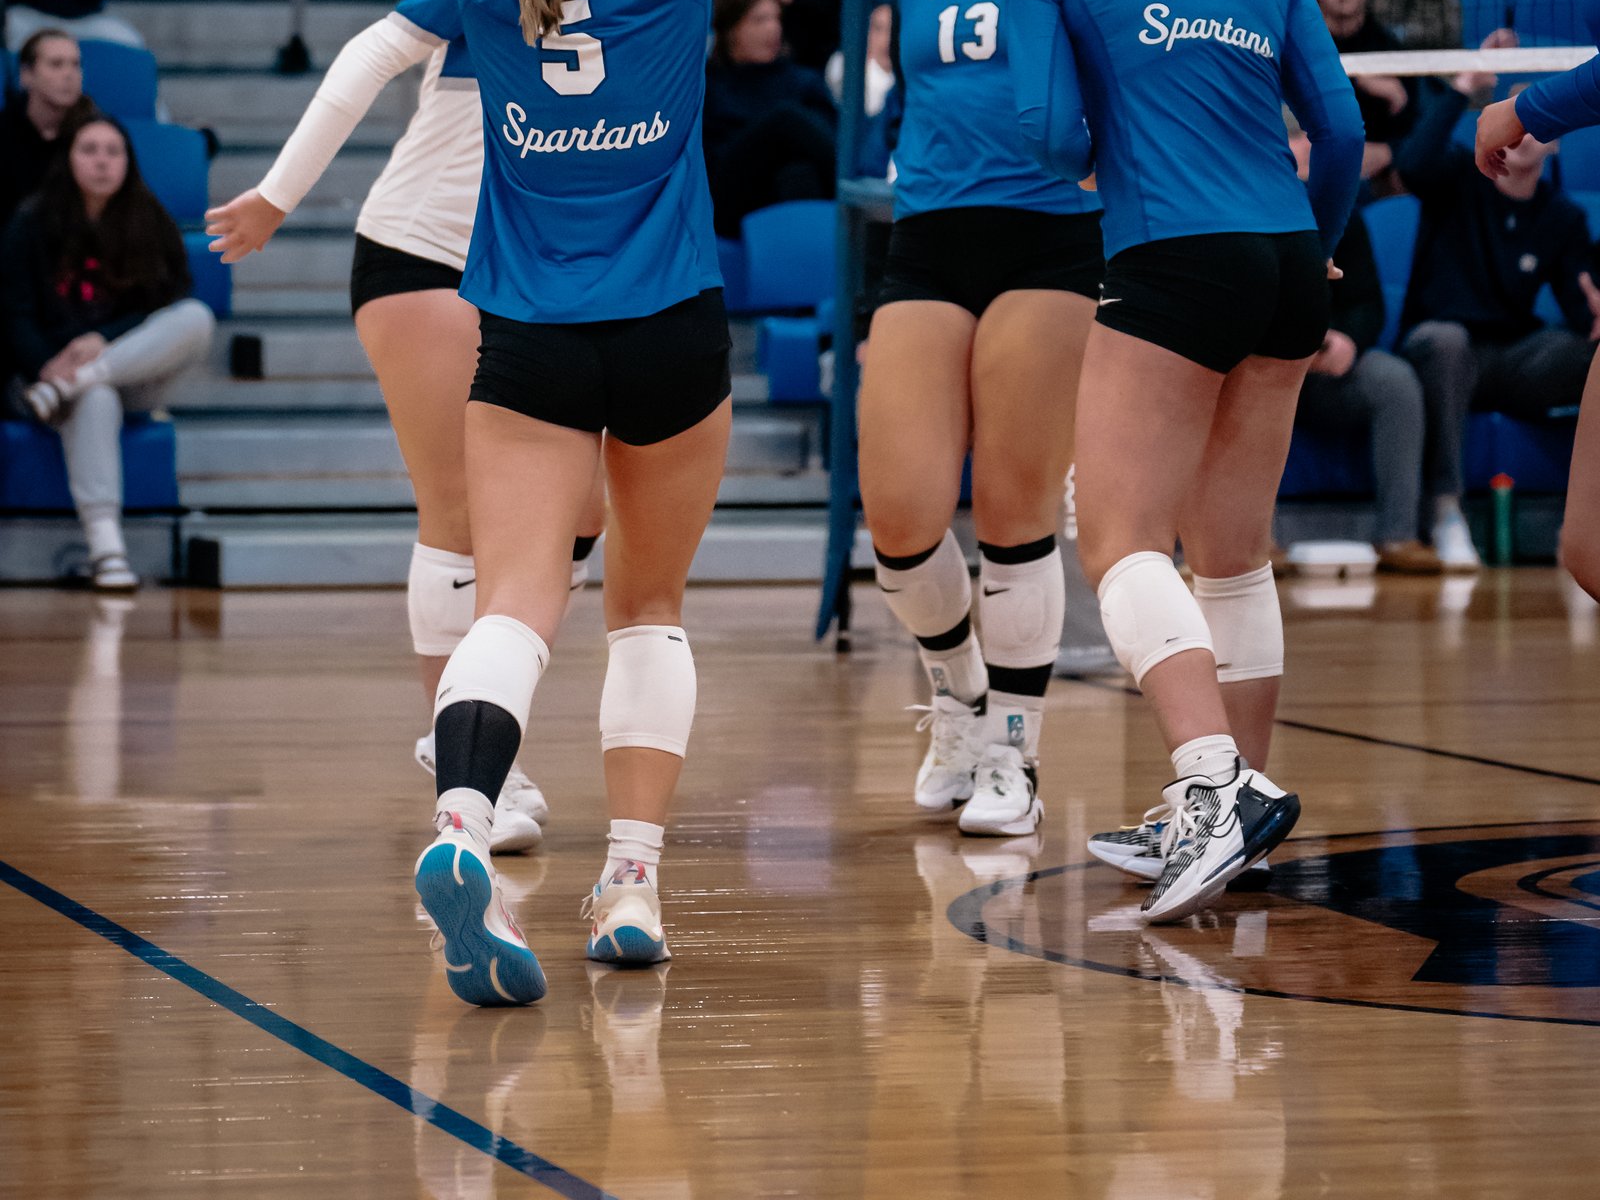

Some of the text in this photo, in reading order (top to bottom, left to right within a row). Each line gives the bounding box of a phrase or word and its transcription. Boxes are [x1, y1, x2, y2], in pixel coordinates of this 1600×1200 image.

[938, 2, 1000, 63] 13
[1138, 3, 1274, 58] Spartans
[502, 101, 671, 159] Spartans
